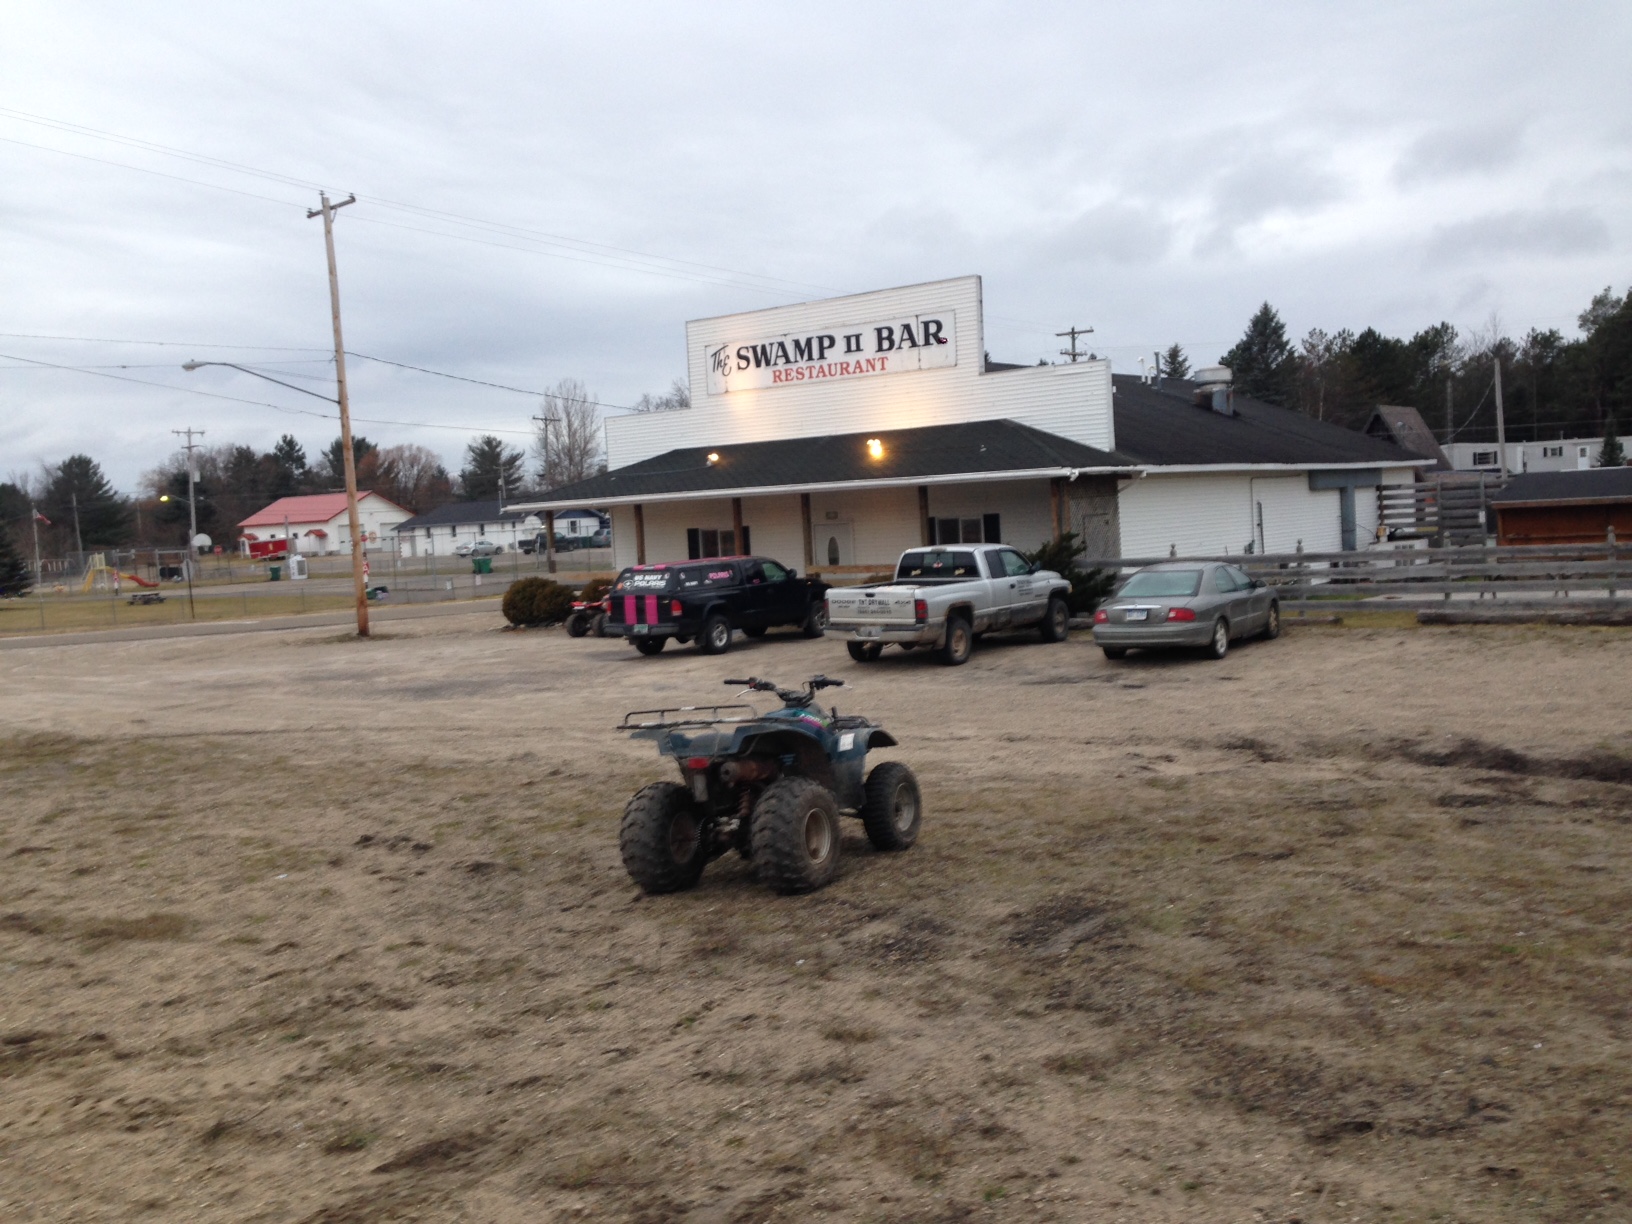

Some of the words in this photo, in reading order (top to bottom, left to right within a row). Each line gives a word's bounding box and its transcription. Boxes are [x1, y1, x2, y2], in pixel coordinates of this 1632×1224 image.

[736, 334, 836, 371] SWAMP
[843, 333, 864, 354] II
[874, 319, 944, 353] BAR
[772, 356, 889, 384] RESTAURANT
